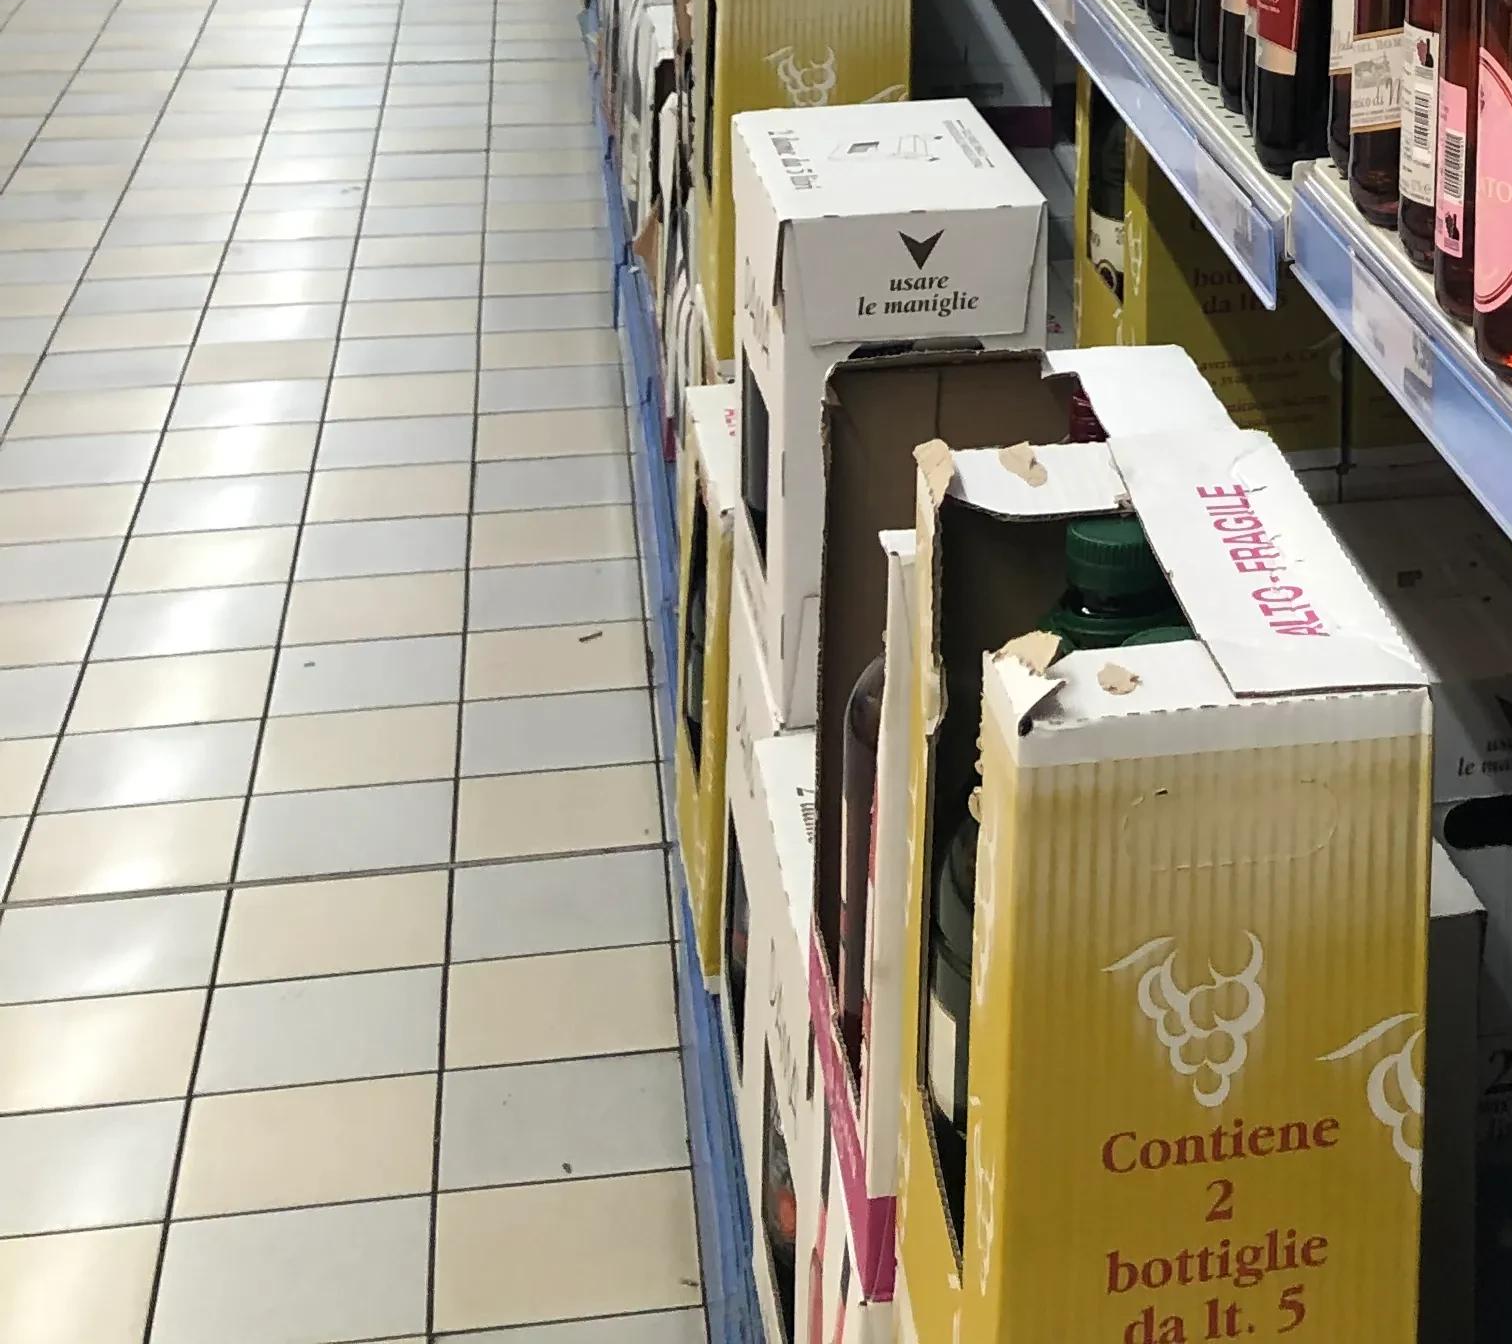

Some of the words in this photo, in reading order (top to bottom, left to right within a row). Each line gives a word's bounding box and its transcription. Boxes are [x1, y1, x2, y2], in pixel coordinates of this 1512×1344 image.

[857, 295, 878, 316] le
[883, 292, 979, 318] maniglie
[889, 273, 950, 293] usare
[1102, 1115, 1340, 1175] Contiene
[1205, 1179, 1234, 1223] 2
[1106, 1228, 1328, 1297] bottiglie
[1124, 1306, 1187, 1344] da
[1206, 1298, 1254, 1342] lt.
[1277, 1284, 1306, 1334] 5
